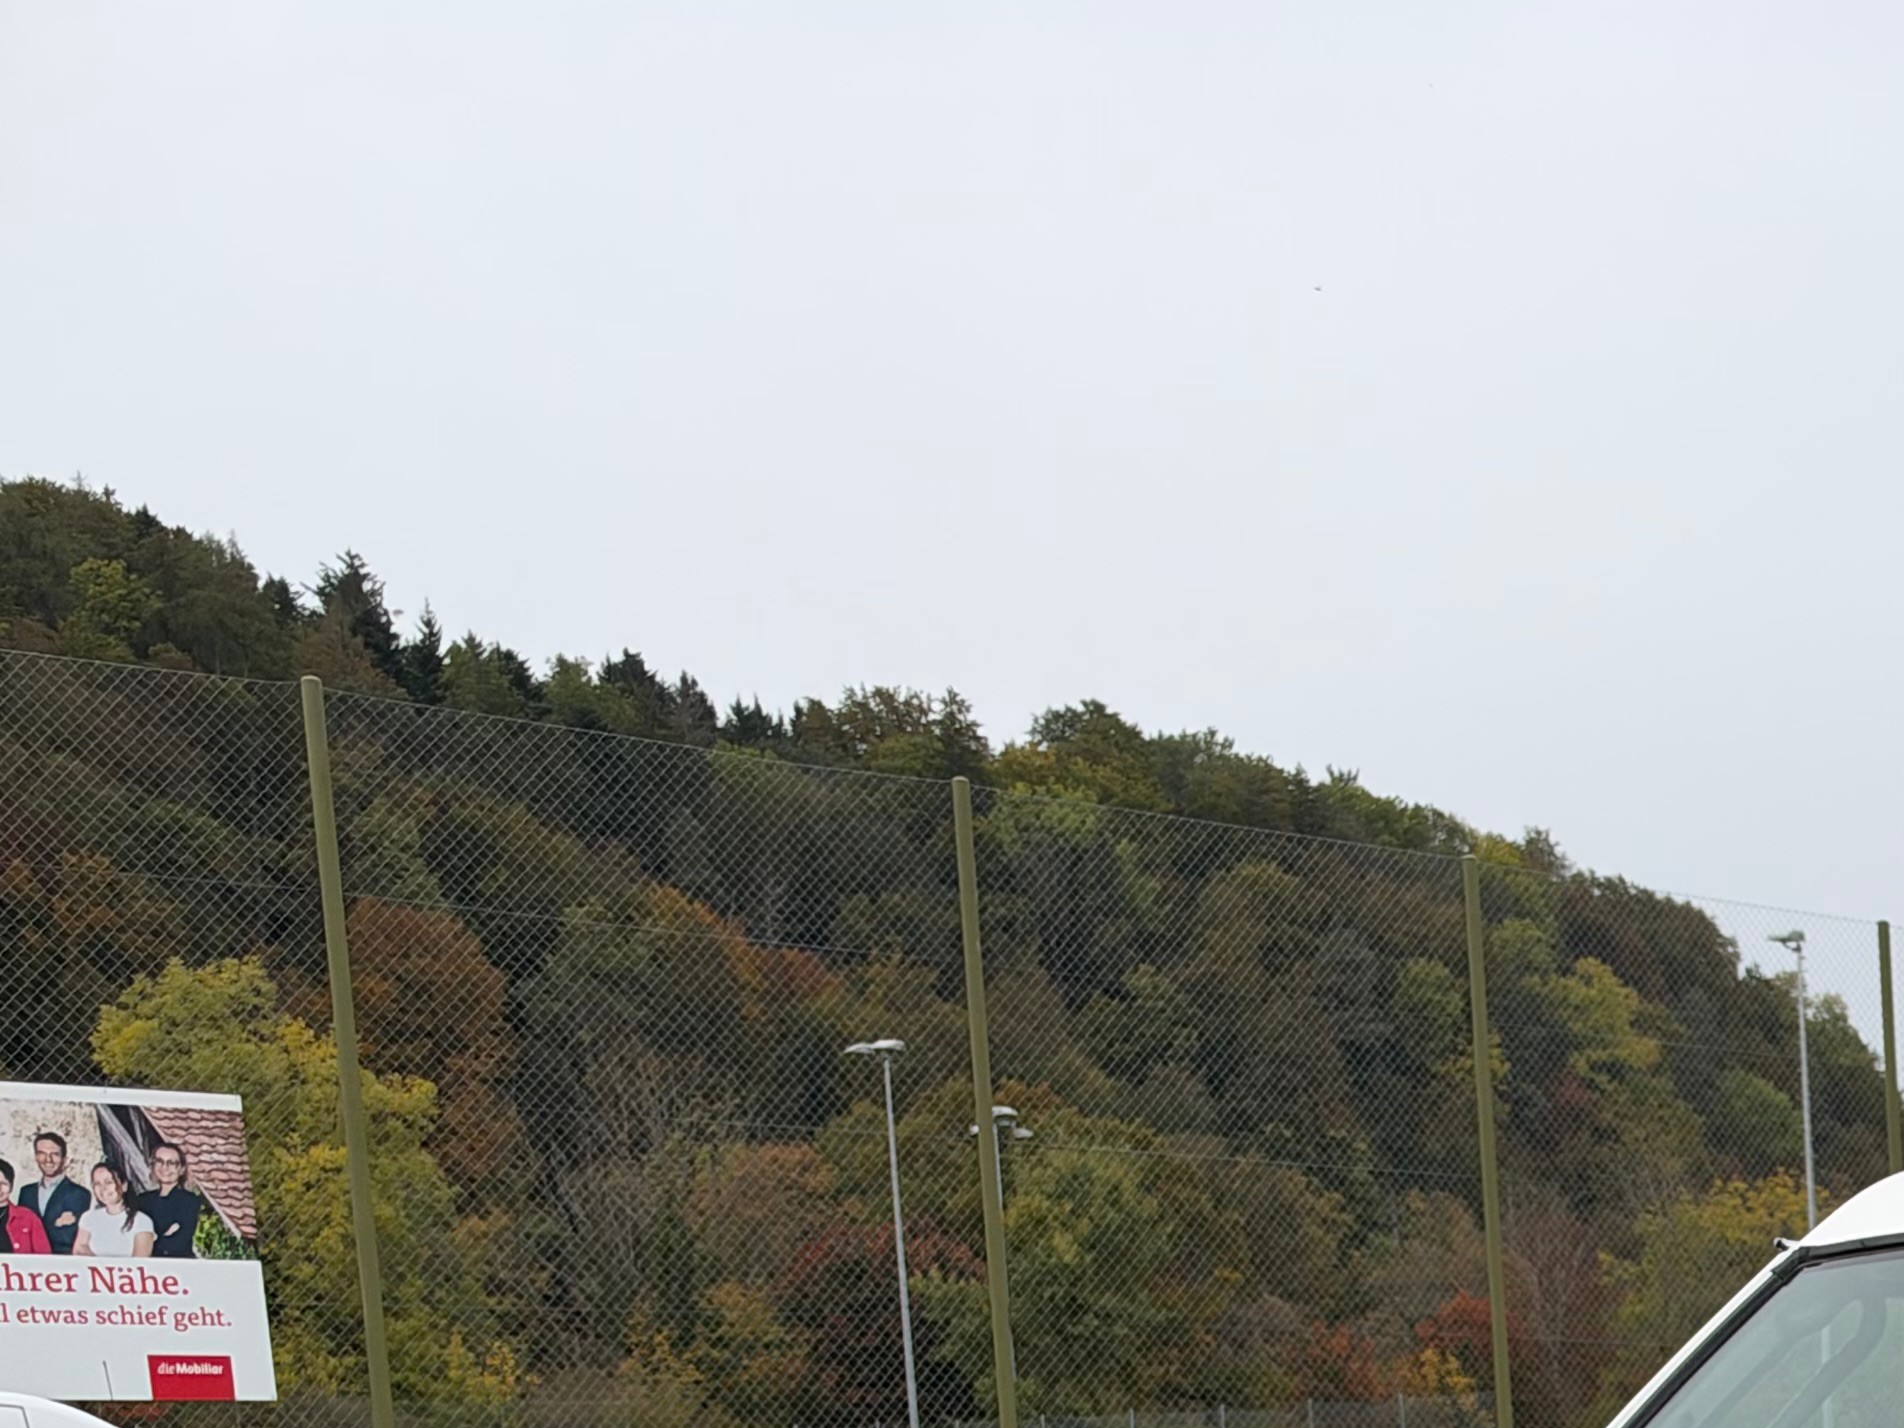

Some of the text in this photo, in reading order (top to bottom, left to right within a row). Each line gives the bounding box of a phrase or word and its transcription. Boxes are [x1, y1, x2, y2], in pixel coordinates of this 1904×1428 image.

[0, 1263, 189, 1295] hrer Nähe.
[16, 1306, 88, 1324] etwas
[95, 1305, 168, 1325] schief
[173, 1306, 232, 1332] geht.
